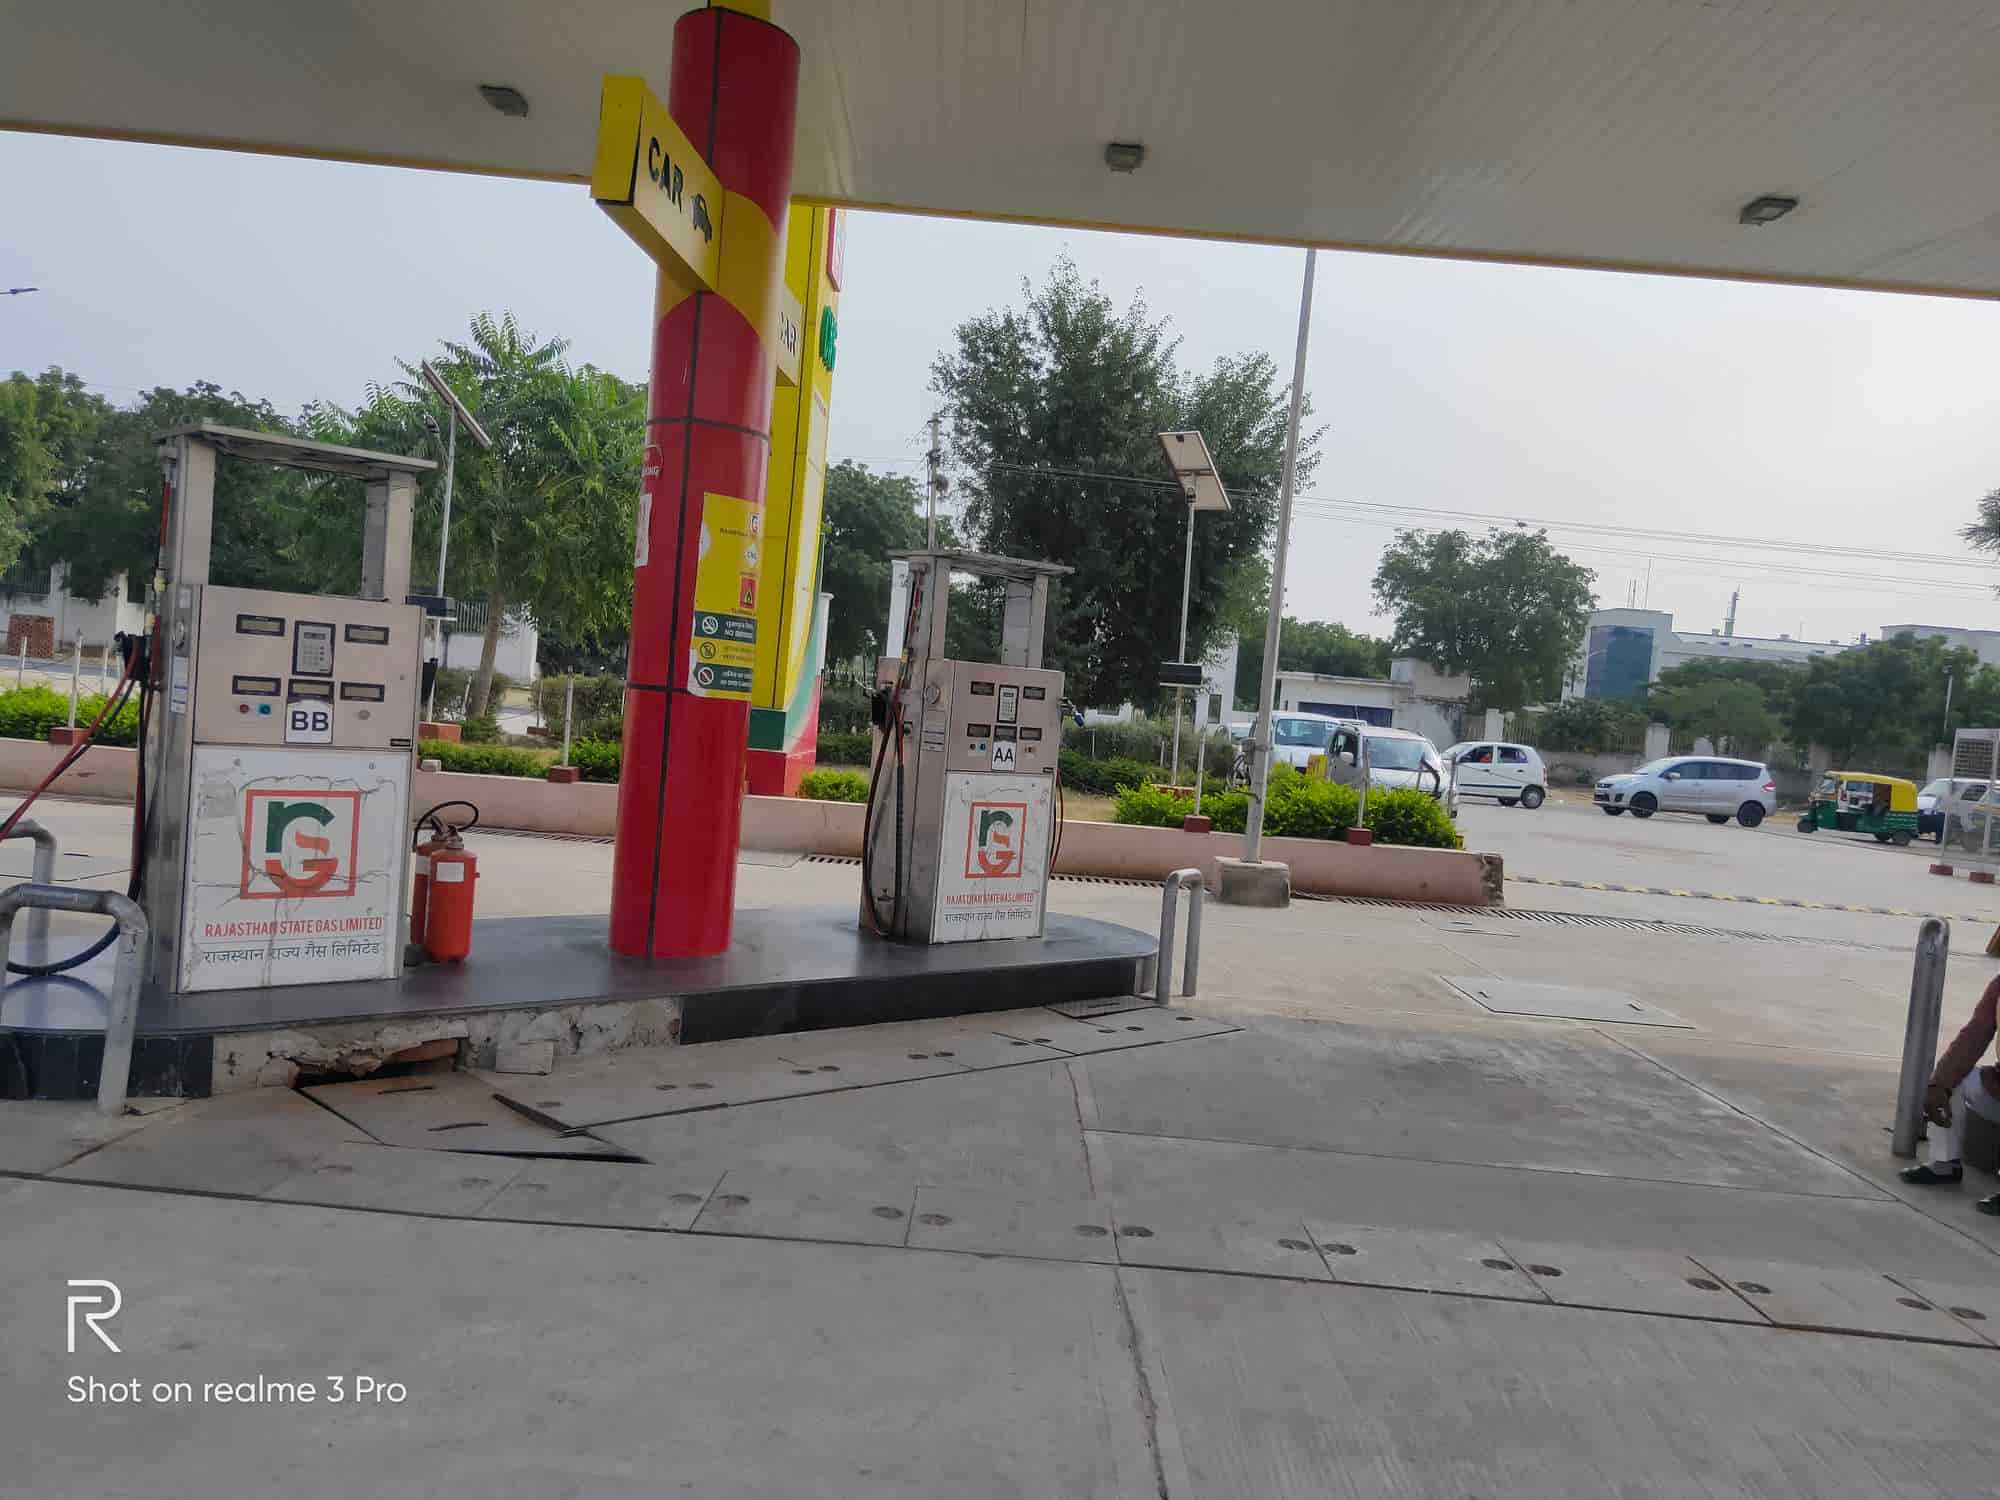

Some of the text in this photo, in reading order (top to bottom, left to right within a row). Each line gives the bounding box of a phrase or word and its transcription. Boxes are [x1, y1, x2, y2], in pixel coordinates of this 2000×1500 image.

[648, 137, 684, 214] CAR
[291, 710, 329, 732] BB
[993, 747, 1014, 763] AA
[204, 921, 276, 937] RAJASTHAN
[279, 919, 313, 934] STATE
[340, 916, 382, 932] LIMITED
